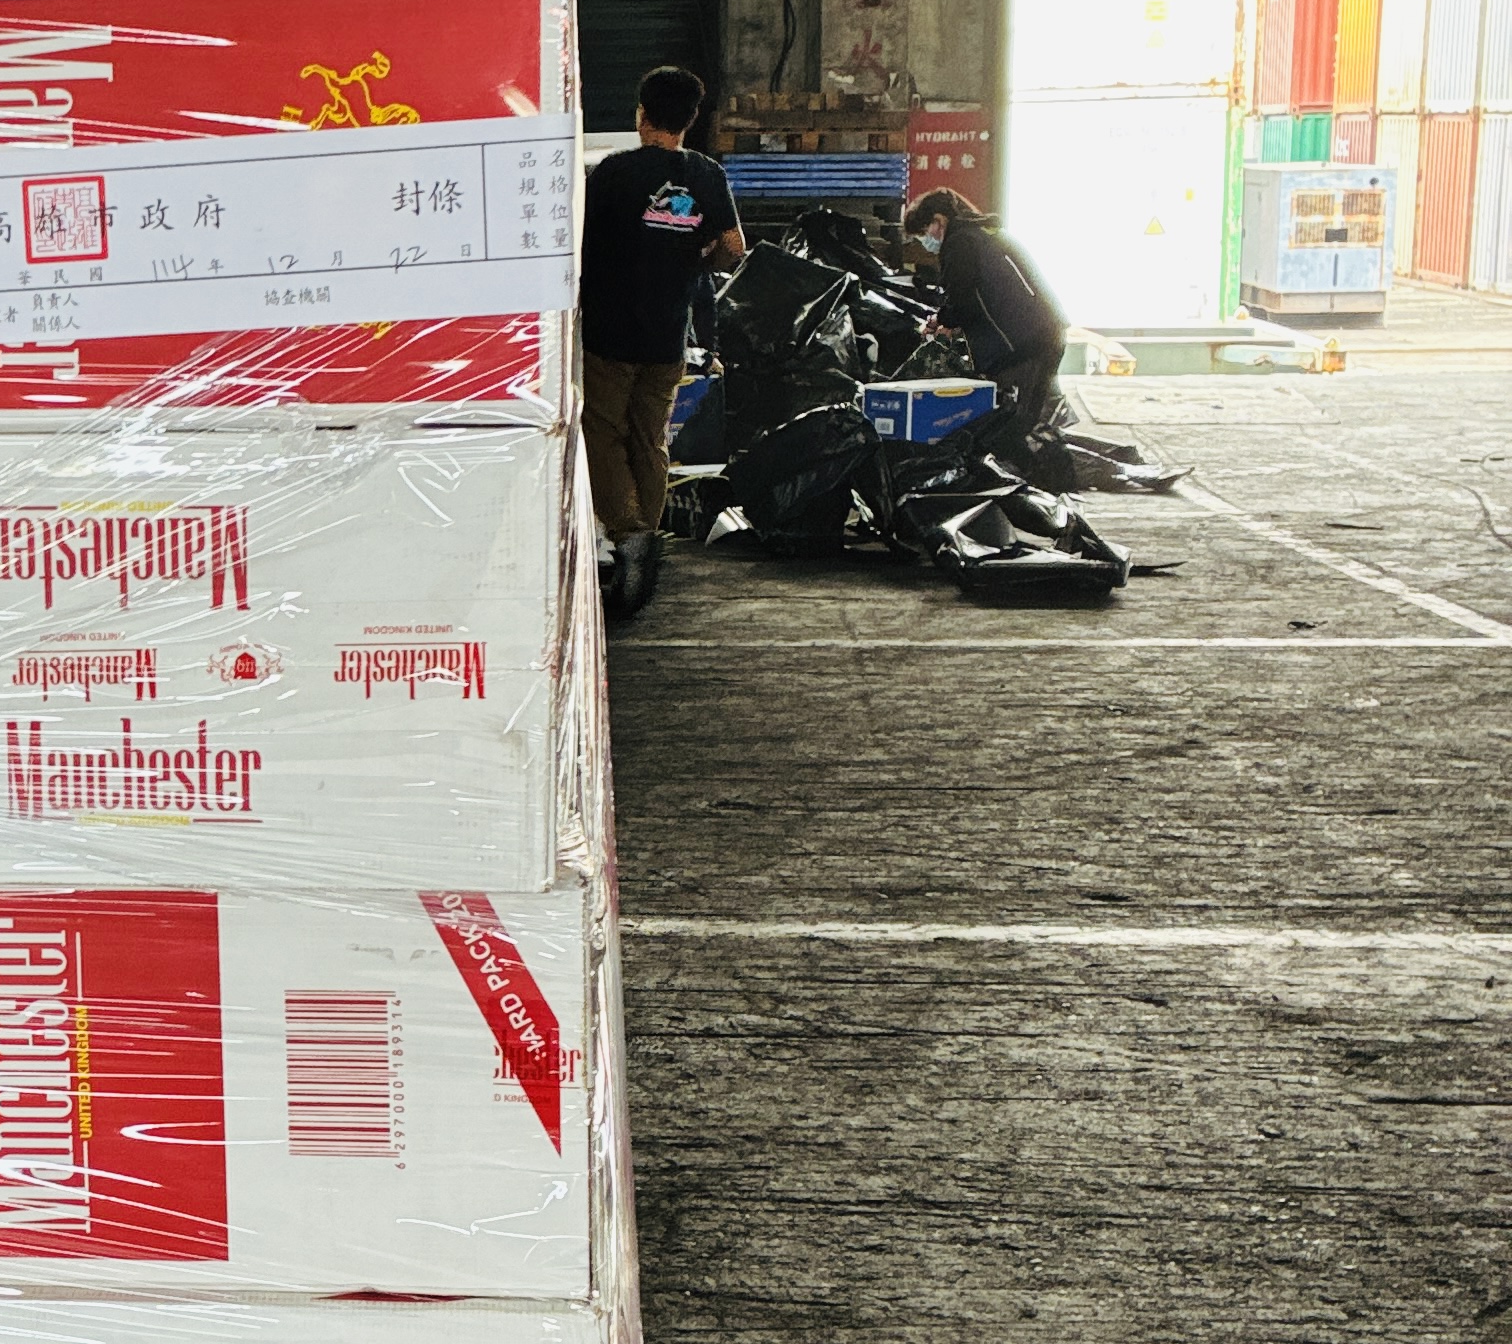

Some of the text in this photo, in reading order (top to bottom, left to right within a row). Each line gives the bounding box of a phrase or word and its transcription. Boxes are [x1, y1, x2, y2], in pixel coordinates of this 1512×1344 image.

[518, 148, 566, 169] 品名
[518, 174, 569, 197] 規格
[391, 179, 465, 217] 封條
[519, 202, 569, 223] 單位
[520, 227, 569, 251] 數量
[151, 254, 195, 282] 114
[207, 258, 224, 275] 年
[267, 253, 299, 275] 12
[330, 250, 344, 267] 月
[461, 243, 472, 258] 日
[32, 292, 79, 312] 負責人
[32, 315, 82, 334] 關係人
[363, 624, 453, 635] UNITED KINGDOM
[12, 647, 159, 703] Manchester
[334, 641, 488, 700] Manchester
[6, 718, 263, 819] Manchester
[390, 998, 404, 1069] 189314
[74, 1005, 93, 1139] UNITED KINGDOM
[394, 1161, 407, 1171] 6
